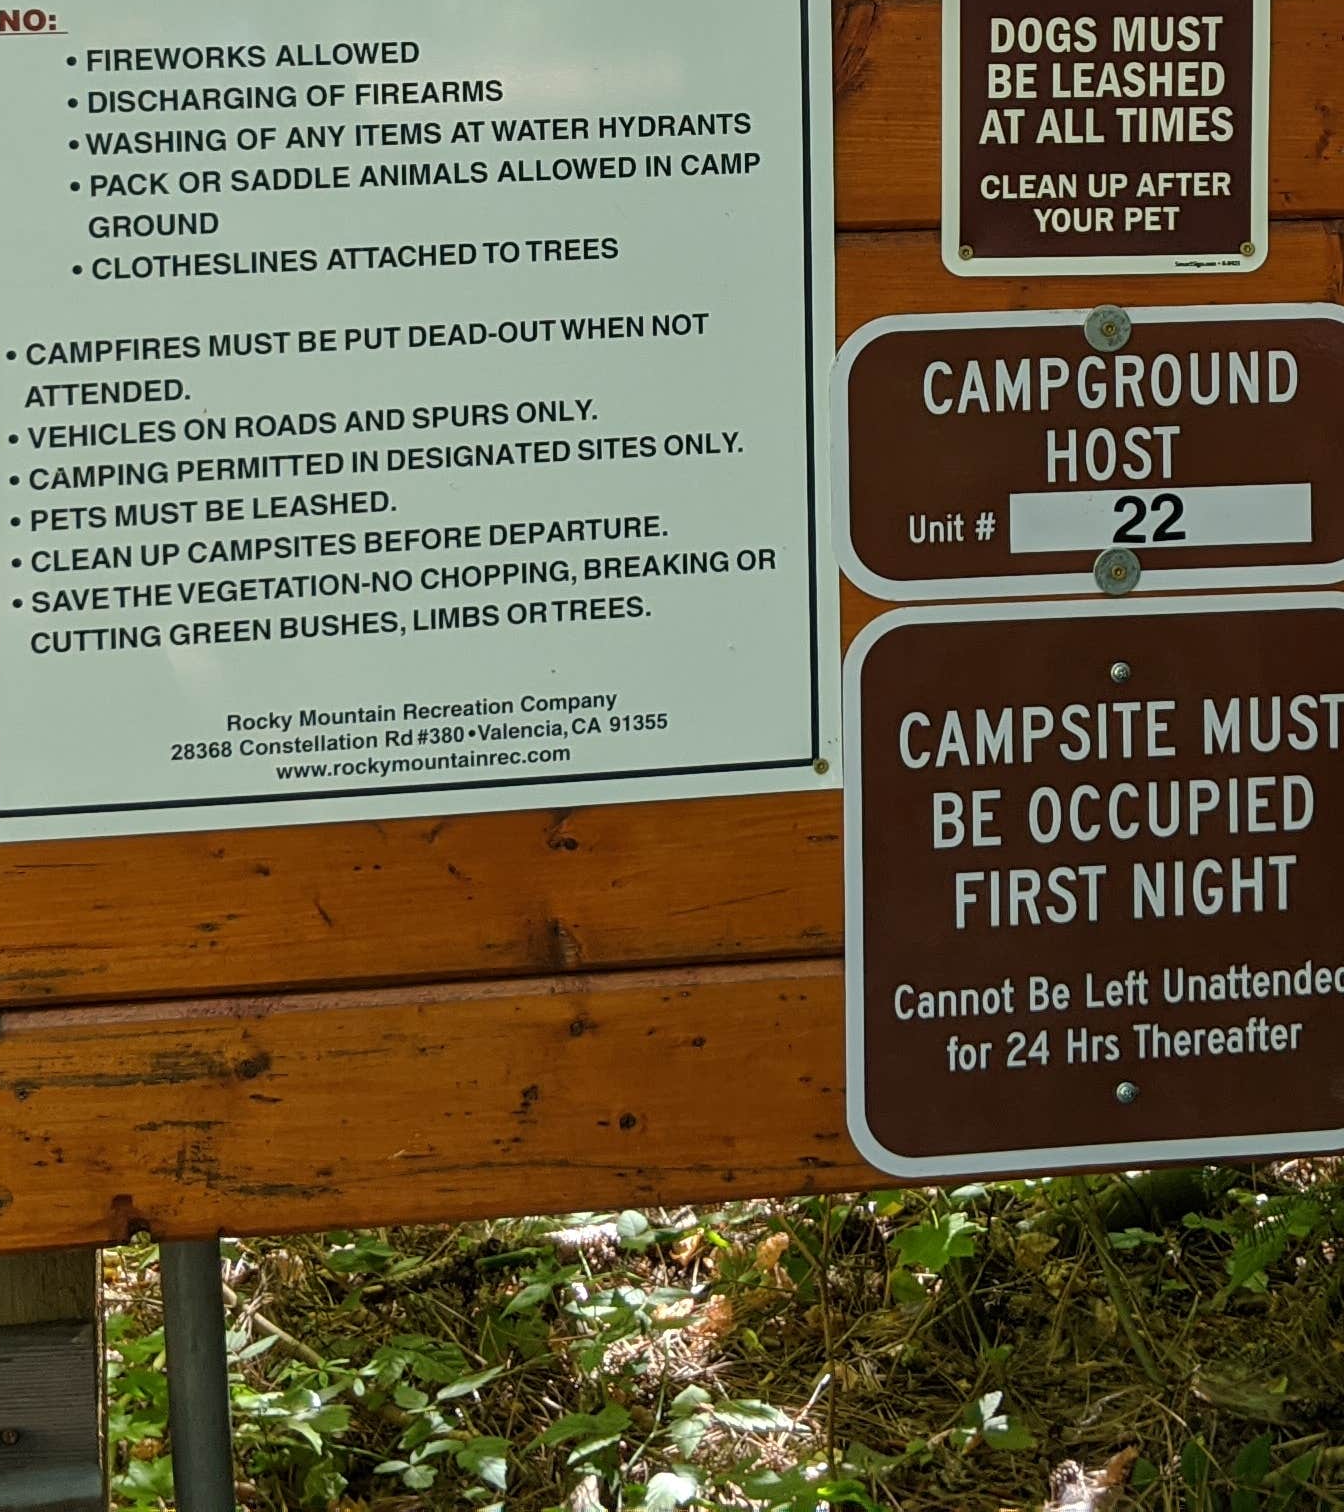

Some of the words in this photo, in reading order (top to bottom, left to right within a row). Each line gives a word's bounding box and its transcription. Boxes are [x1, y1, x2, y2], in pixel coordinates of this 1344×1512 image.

[991, 17, 1096, 53] DOGS
[1114, 16, 1222, 51] MUST
[87, 46, 265, 71] FIREWORKS
[276, 42, 419, 66] ALLOWED
[89, 86, 296, 113] DISCHARGING
[307, 85, 345, 106] OF
[356, 80, 503, 105] FIREARMS
[988, 64, 1037, 98] BE
[1053, 62, 1224, 98] LEASHED
[979, 109, 1025, 144] AT
[1036, 108, 1104, 143] ALL
[1116, 107, 1233, 142] TIMES
[981, 174, 1076, 199] CLEAN
[1089, 174, 1127, 197] UP
[1136, 173, 1230, 197] AFTER
[1034, 208, 1113, 232] YOUR
[1125, 207, 1179, 231] PET
[924, 351, 1297, 414] CAMPGROUND
[1047, 426, 1180, 482] HOST
[32, 507, 106, 531] PETS
[116, 501, 197, 526] MUST
[206, 499, 244, 521] BE
[253, 491, 396, 519] LEASHED.
[910, 514, 964, 543] Unit
[1113, 493, 1185, 543] 22
[228, 712, 292, 732] Rocky
[300, 705, 395, 726] Mountain
[404, 700, 513, 720] Recreation
[521, 694, 617, 713] Company
[900, 701, 1175, 768] CAMPSITE
[276, 747, 571, 780] www.rockymountainrec.com
[934, 790, 1001, 848] BE
[1029, 775, 1313, 843] OCCUPIED
[956, 865, 1106, 928] FIRST
[1134, 855, 1296, 918] NIGHT
[895, 979, 1014, 1019] Cannot
[1030, 977, 1069, 1011] Be
[1087, 971, 1148, 1008] Left
[947, 1036, 992, 1071] for
[1007, 1031, 1049, 1066] 24
[1068, 1028, 1119, 1063] Hrs
[1133, 1017, 1302, 1058] Thereafter
